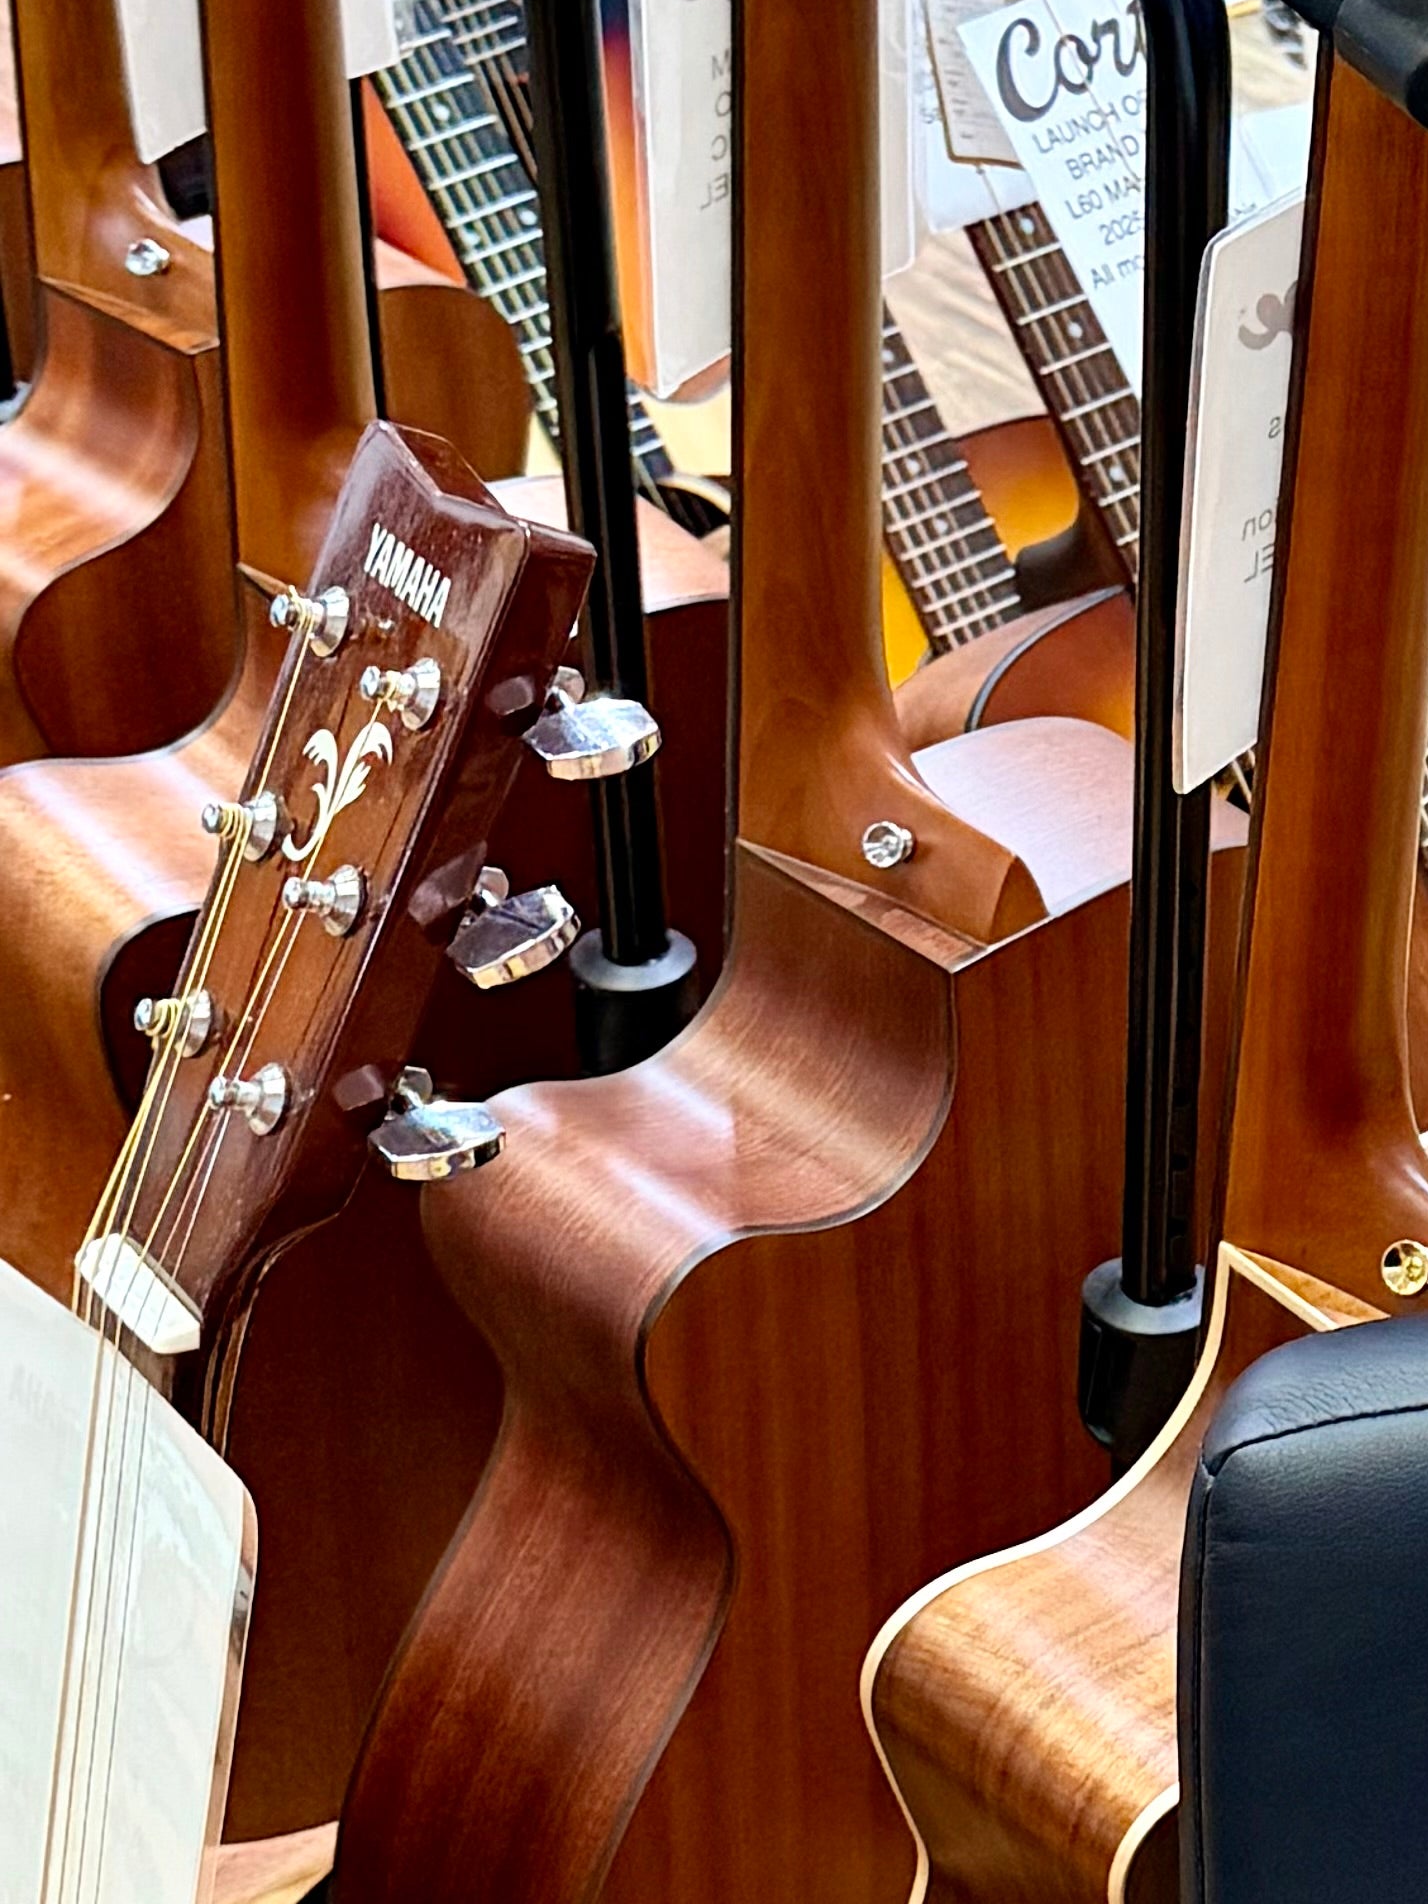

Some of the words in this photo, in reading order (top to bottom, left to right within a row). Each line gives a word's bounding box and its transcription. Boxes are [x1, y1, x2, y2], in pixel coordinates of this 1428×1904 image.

[1032, 103, 1117, 154] LAUNCH
[1065, 135, 1140, 180] BRAND
[363, 521, 452, 629] YAMAHA
